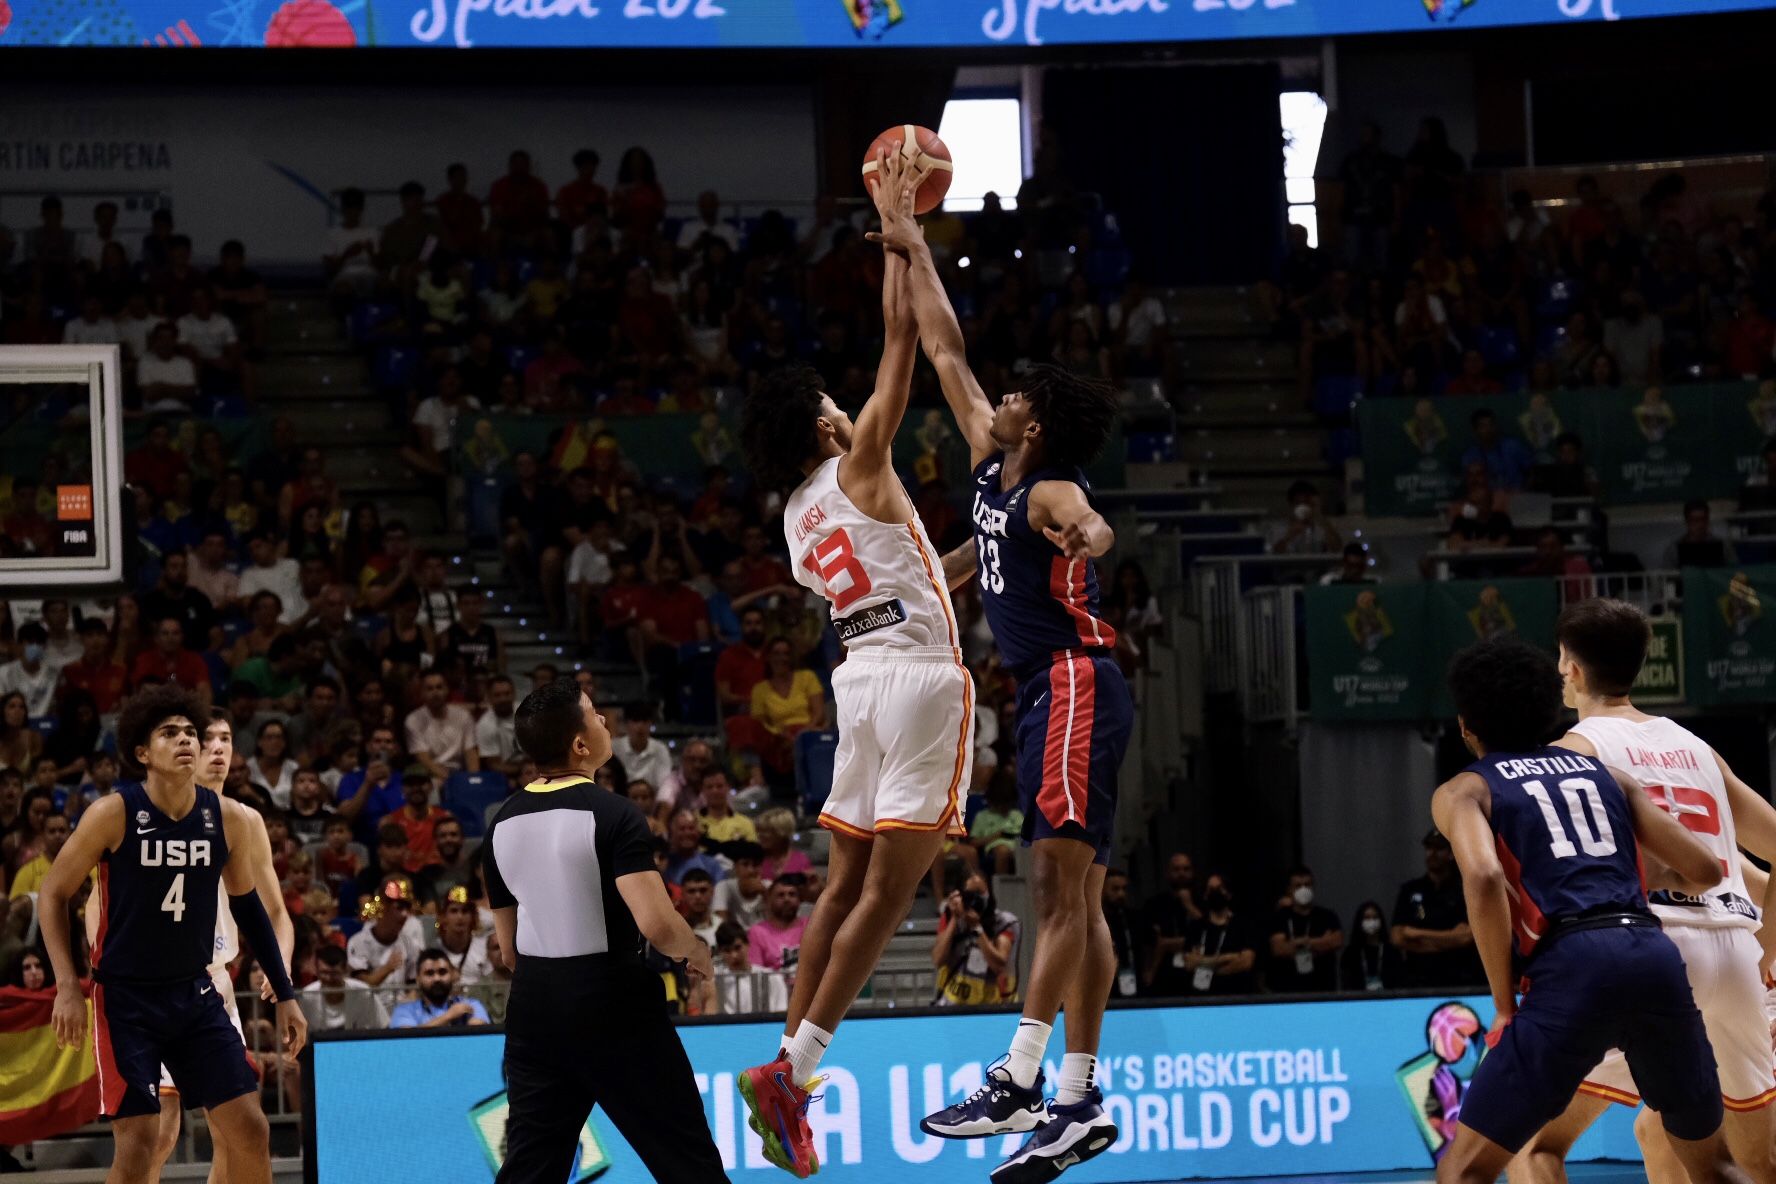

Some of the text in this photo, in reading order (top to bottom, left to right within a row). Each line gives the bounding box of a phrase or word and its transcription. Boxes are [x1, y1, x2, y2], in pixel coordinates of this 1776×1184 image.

[59, 142, 171, 172] CARPENA
[63, 530, 88, 544] FIBA
[972, 491, 1010, 539] USA
[977, 534, 1005, 595] 13
[1495, 755, 1597, 780] CASTILLO
[1521, 777, 1618, 859] 10
[141, 839, 211, 867] USA
[160, 872, 186, 922] 4
[1045, 1047, 1348, 1094] MN'S BASKETBALL
[1102, 1086, 1351, 1155] ORLD CUP
